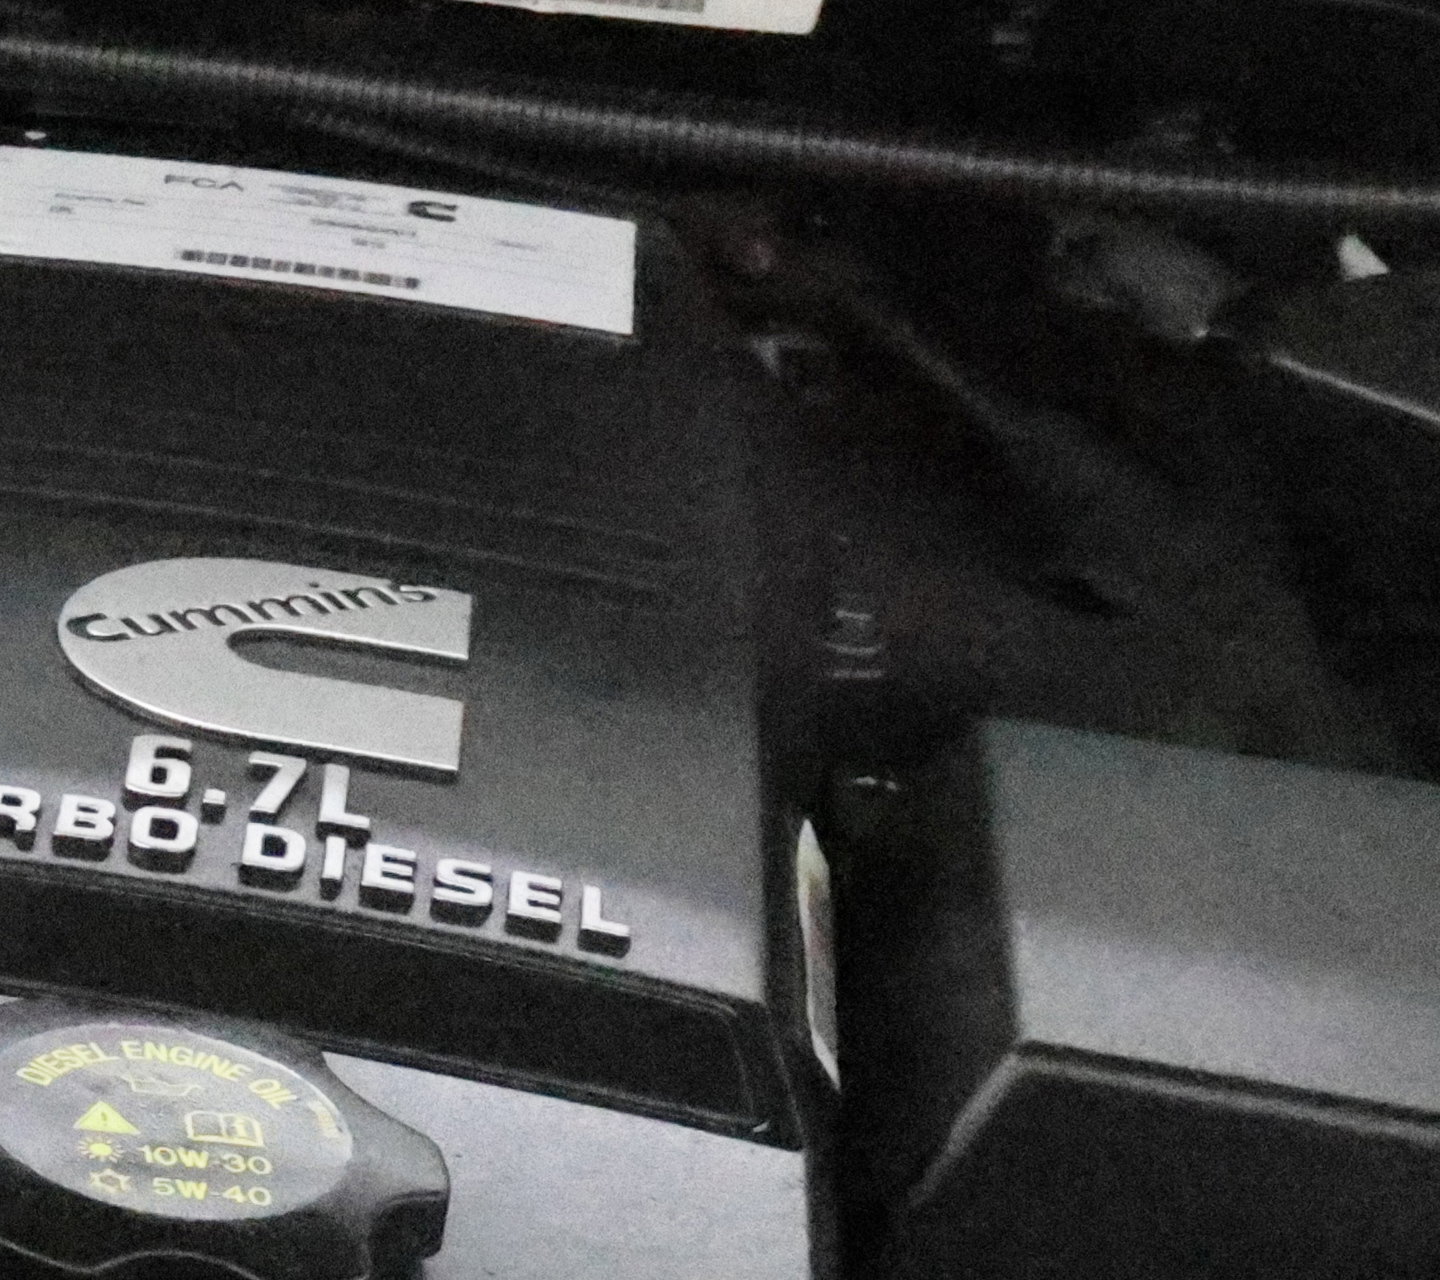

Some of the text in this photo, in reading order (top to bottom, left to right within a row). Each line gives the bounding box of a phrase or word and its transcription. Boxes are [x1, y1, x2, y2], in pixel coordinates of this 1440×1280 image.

[164, 173, 244, 193] FCA
[66, 581, 438, 643] Cummins
[124, 733, 371, 840] 6.7L
[238, 821, 632, 954] DIESEL
[16, 1039, 298, 1110] DIESEL ENGINE OIL
[139, 1145, 273, 1175] 10W-30
[152, 1177, 273, 1207] 5W-40
